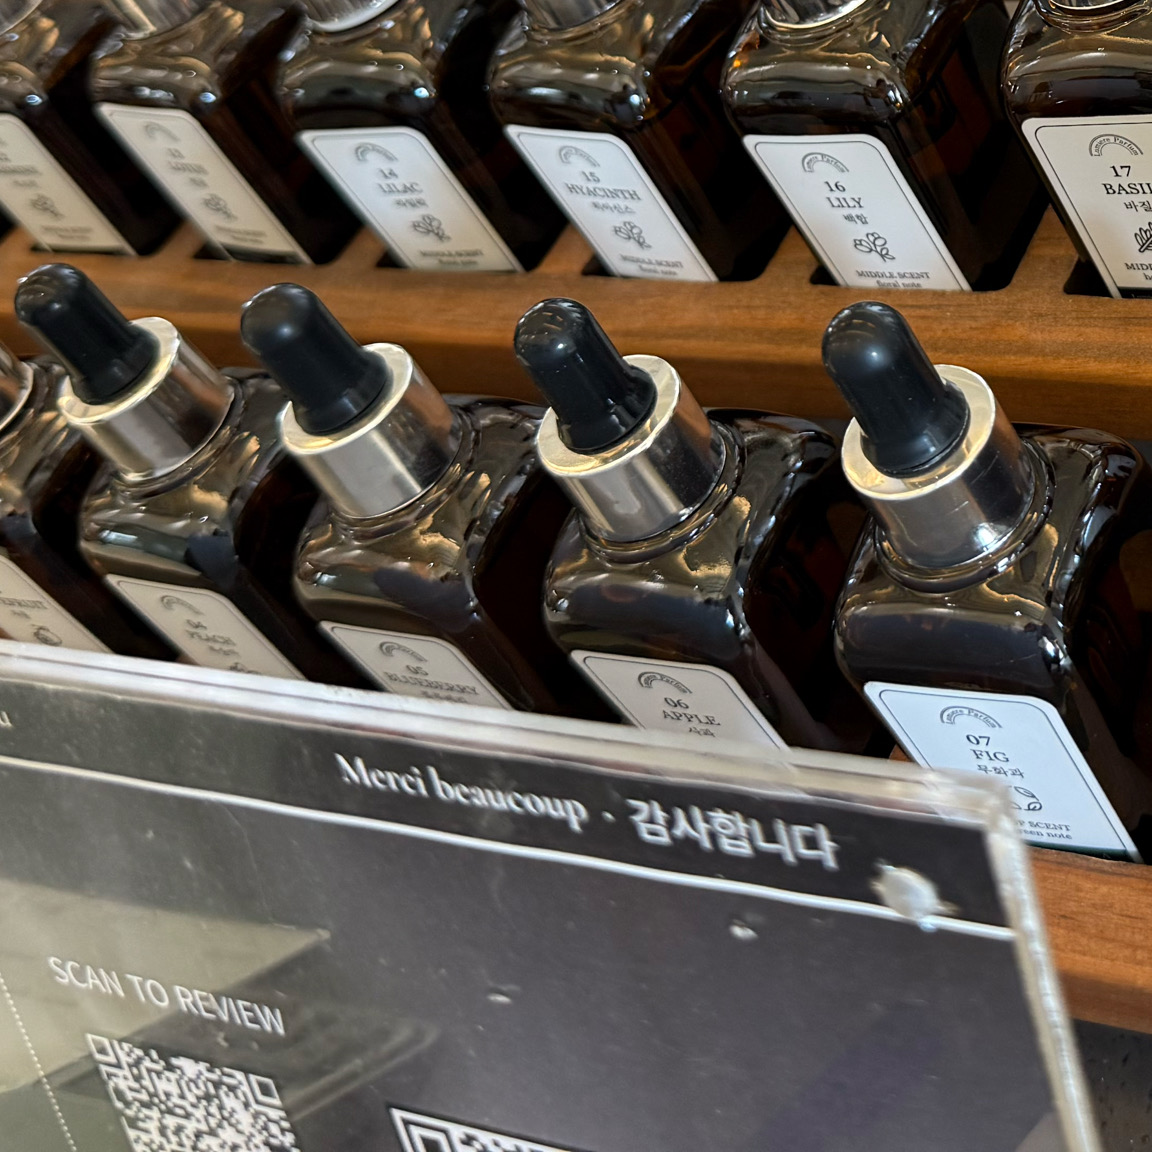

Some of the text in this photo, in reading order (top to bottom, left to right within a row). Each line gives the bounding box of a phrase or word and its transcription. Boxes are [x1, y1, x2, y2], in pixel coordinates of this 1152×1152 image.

[582, 171, 601, 183] 15
[1110, 166, 1131, 177] 17
[378, 183, 424, 194] LILAC
[565, 182, 642, 201] HYACINTH
[825, 181, 846, 192] 16
[826, 197, 864, 209] LILY
[384, 672, 479, 695] BLUEBERRY
[664, 697, 689, 709] 06
[662, 710, 721, 726] APPLE
[966, 734, 990, 746] 07
[970, 749, 1010, 763] FIG
[977, 765, 1024, 778] 무화과
[336, 752, 840, 872] Merci beaucoup 감사합니다
[1028, 821, 1070, 831] SCENT
[47, 956, 286, 1036] SCAN TO REVIEW
